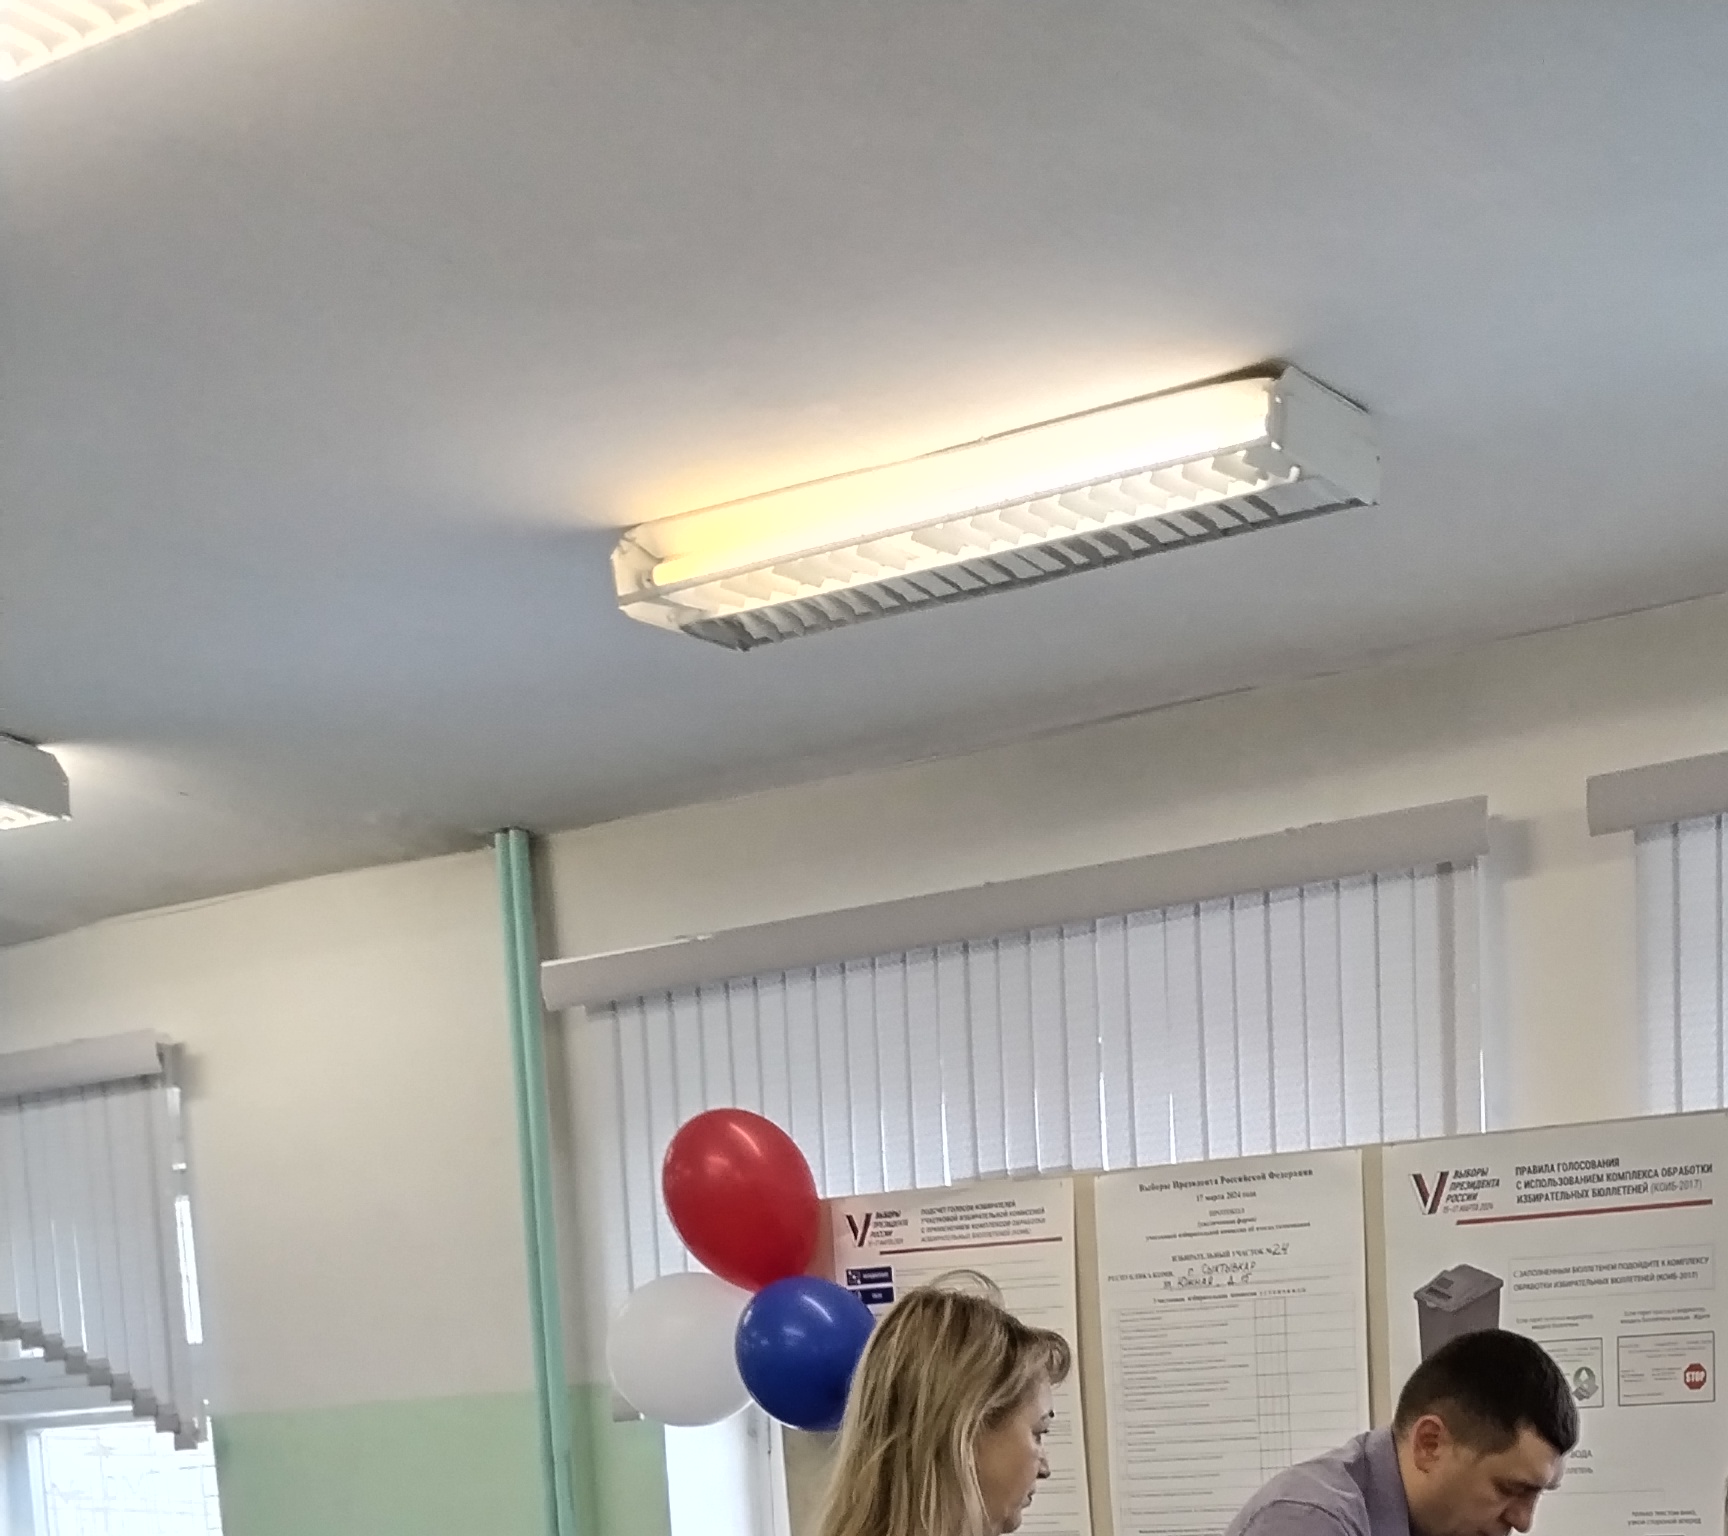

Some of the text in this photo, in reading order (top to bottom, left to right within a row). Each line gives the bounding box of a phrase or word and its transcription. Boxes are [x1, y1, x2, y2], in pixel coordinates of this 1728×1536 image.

[1453, 1167, 1489, 1179] ВЫБОРЫ
[1515, 1157, 1619, 1176] ПРАВИЛА ГОЛОСОВАНИЯ
[1449, 1178, 1500, 1191] ПРЕЗИДЕНТА
[1516, 1163, 1712, 1190] С ИСПОЛЬЗОВАНИЕМ КОМПЛЕКСА ОБРАБОТКИ
[1517, 1189, 1589, 1204] ИЗБИРАТЕЛЬНЫХ
[1592, 1182, 1648, 1198] БЮЛЛЕТЕНЕЙ
[1686, 1371, 1705, 1383] STOP
